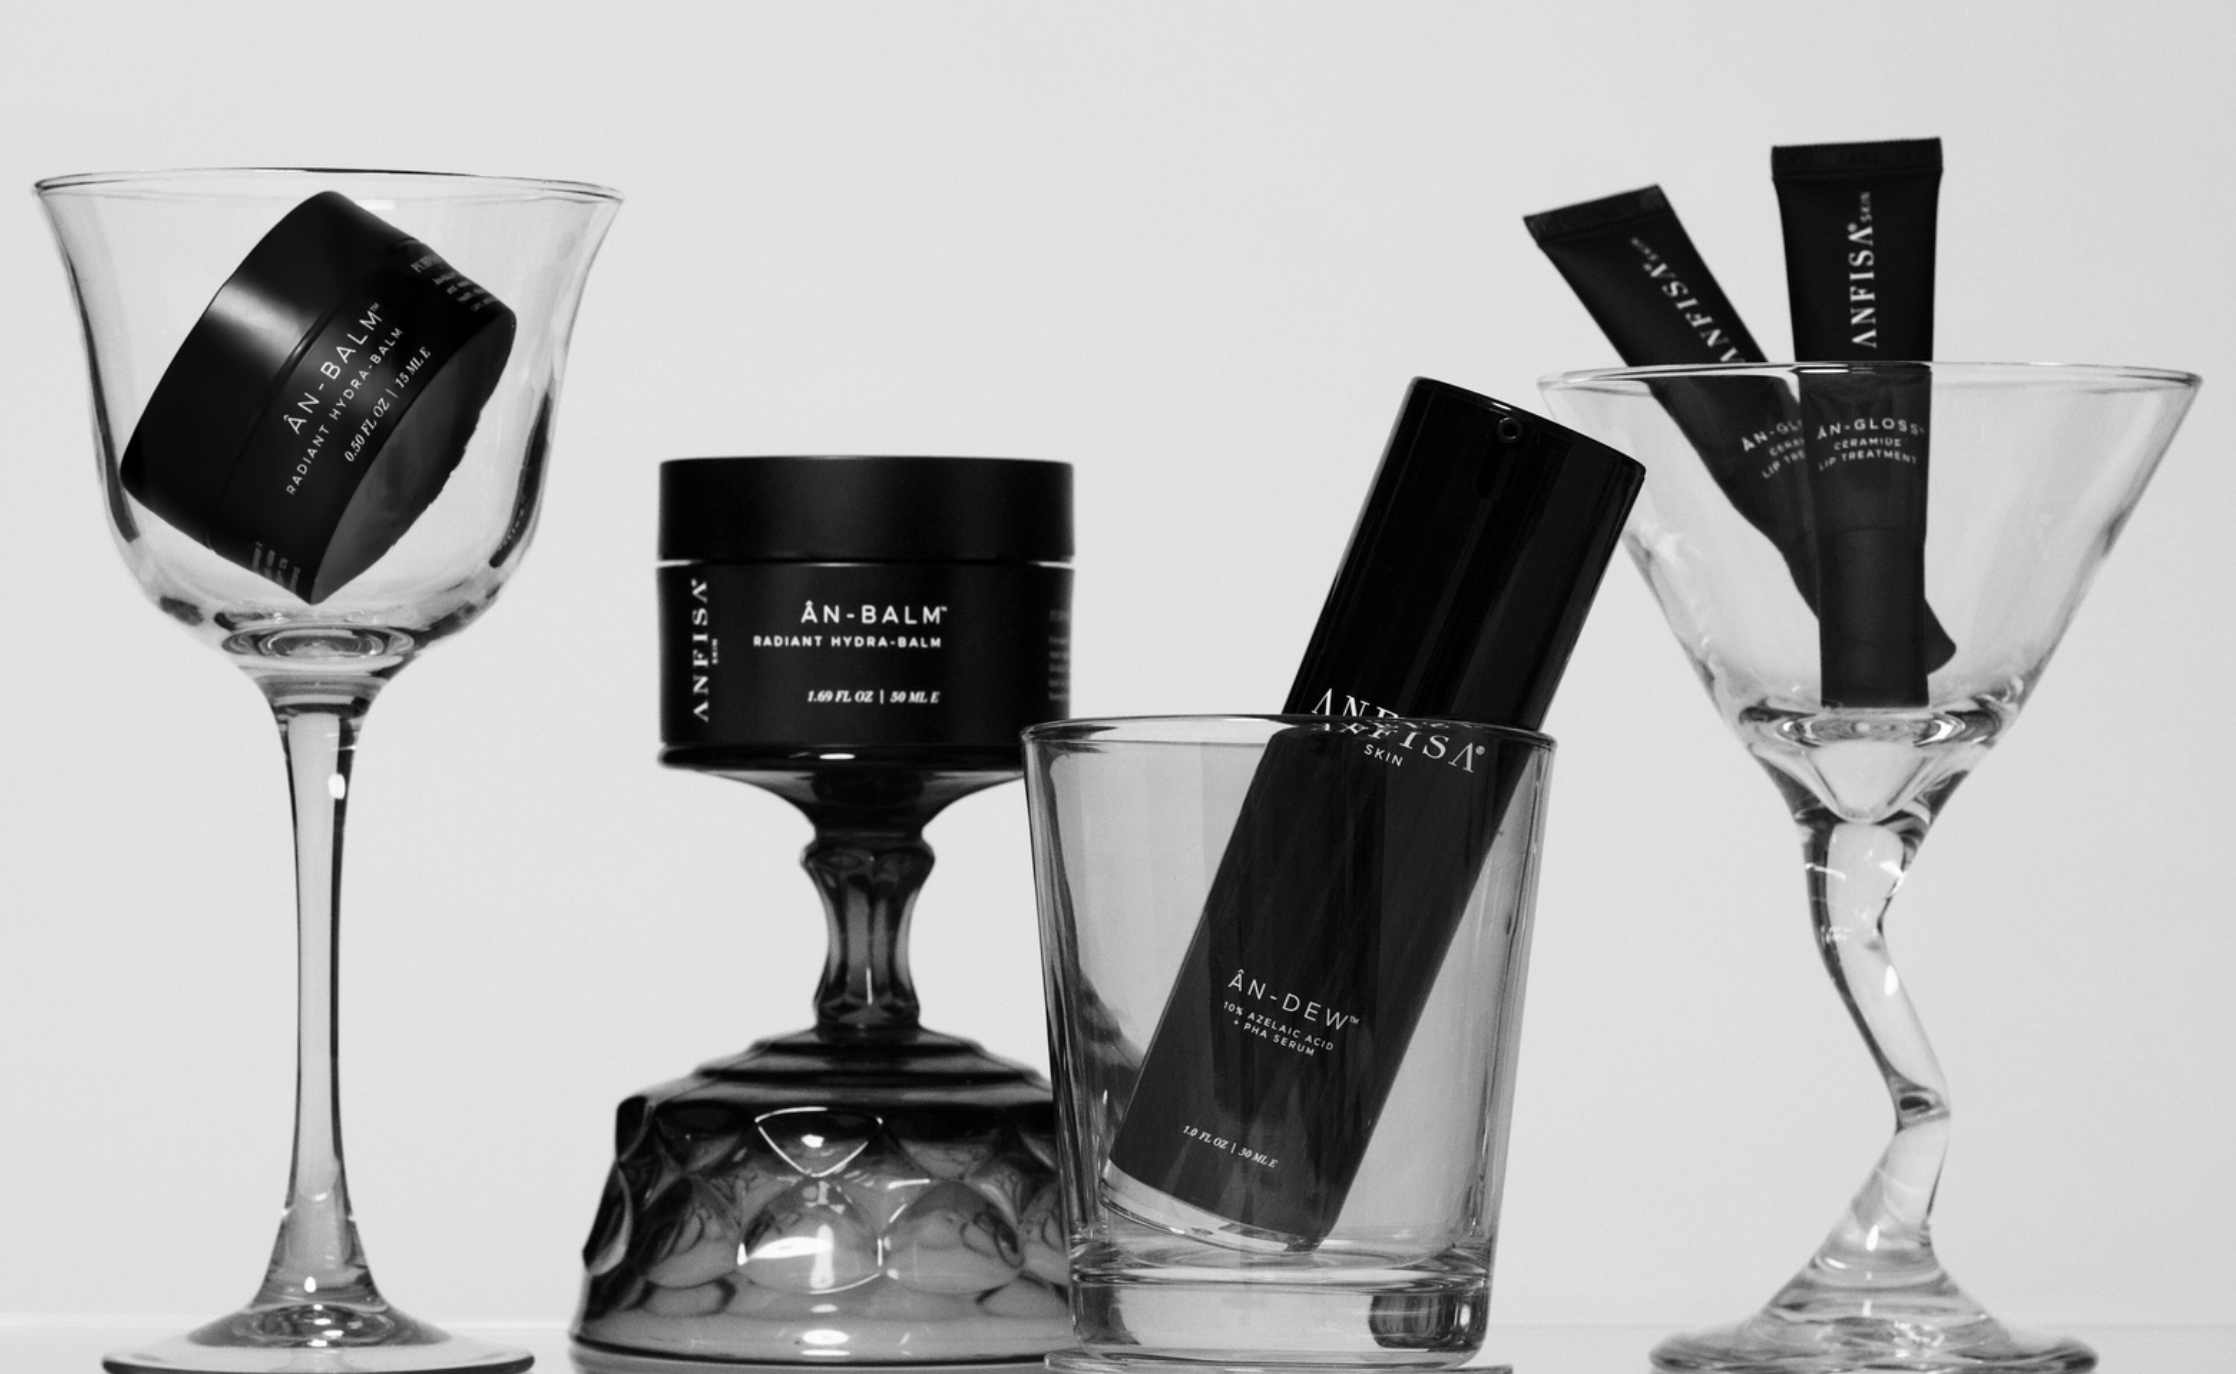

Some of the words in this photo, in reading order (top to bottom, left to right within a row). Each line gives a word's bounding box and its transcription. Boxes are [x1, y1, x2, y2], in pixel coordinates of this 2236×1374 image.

[286, 424, 330, 495] RADIANT
[329, 327, 403, 421] HYDRA-BALM
[344, 434, 365, 462] 0.50
[360, 418, 377, 437] FL
[372, 397, 390, 418] OZ
[395, 372, 410, 389] 15
[406, 357, 424, 376] ML
[1833, 436, 1901, 451] CERAMIDE
[1819, 456, 1837, 472] LIP
[1841, 449, 1917, 465] TREATMENT
[753, 635, 823, 648] RADIANT
[831, 636, 942, 648] HYDRA-BALM
[807, 690, 834, 703] 1.69
[835, 690, 852, 703] FL
[854, 690, 874, 703] OZ
[889, 691, 907, 703] 50
[908, 691, 928, 704] ML
[1363, 743, 1404, 767] SKIN
[1223, 1001, 1244, 1016] 10%
[1247, 1012, 1301, 1039] AZELAIC
[1304, 1034, 1334, 1051] ACID
[1243, 1022, 1267, 1039] PHA
[1273, 1034, 1315, 1057] SERUM
[1182, 1125, 1199, 1138] 1.0
[1198, 1131, 1212, 1144] FL
[1212, 1137, 1230, 1150] OZ
[1237, 1147, 1253, 1159] 30
[1251, 1152, 1268, 1166] ML
